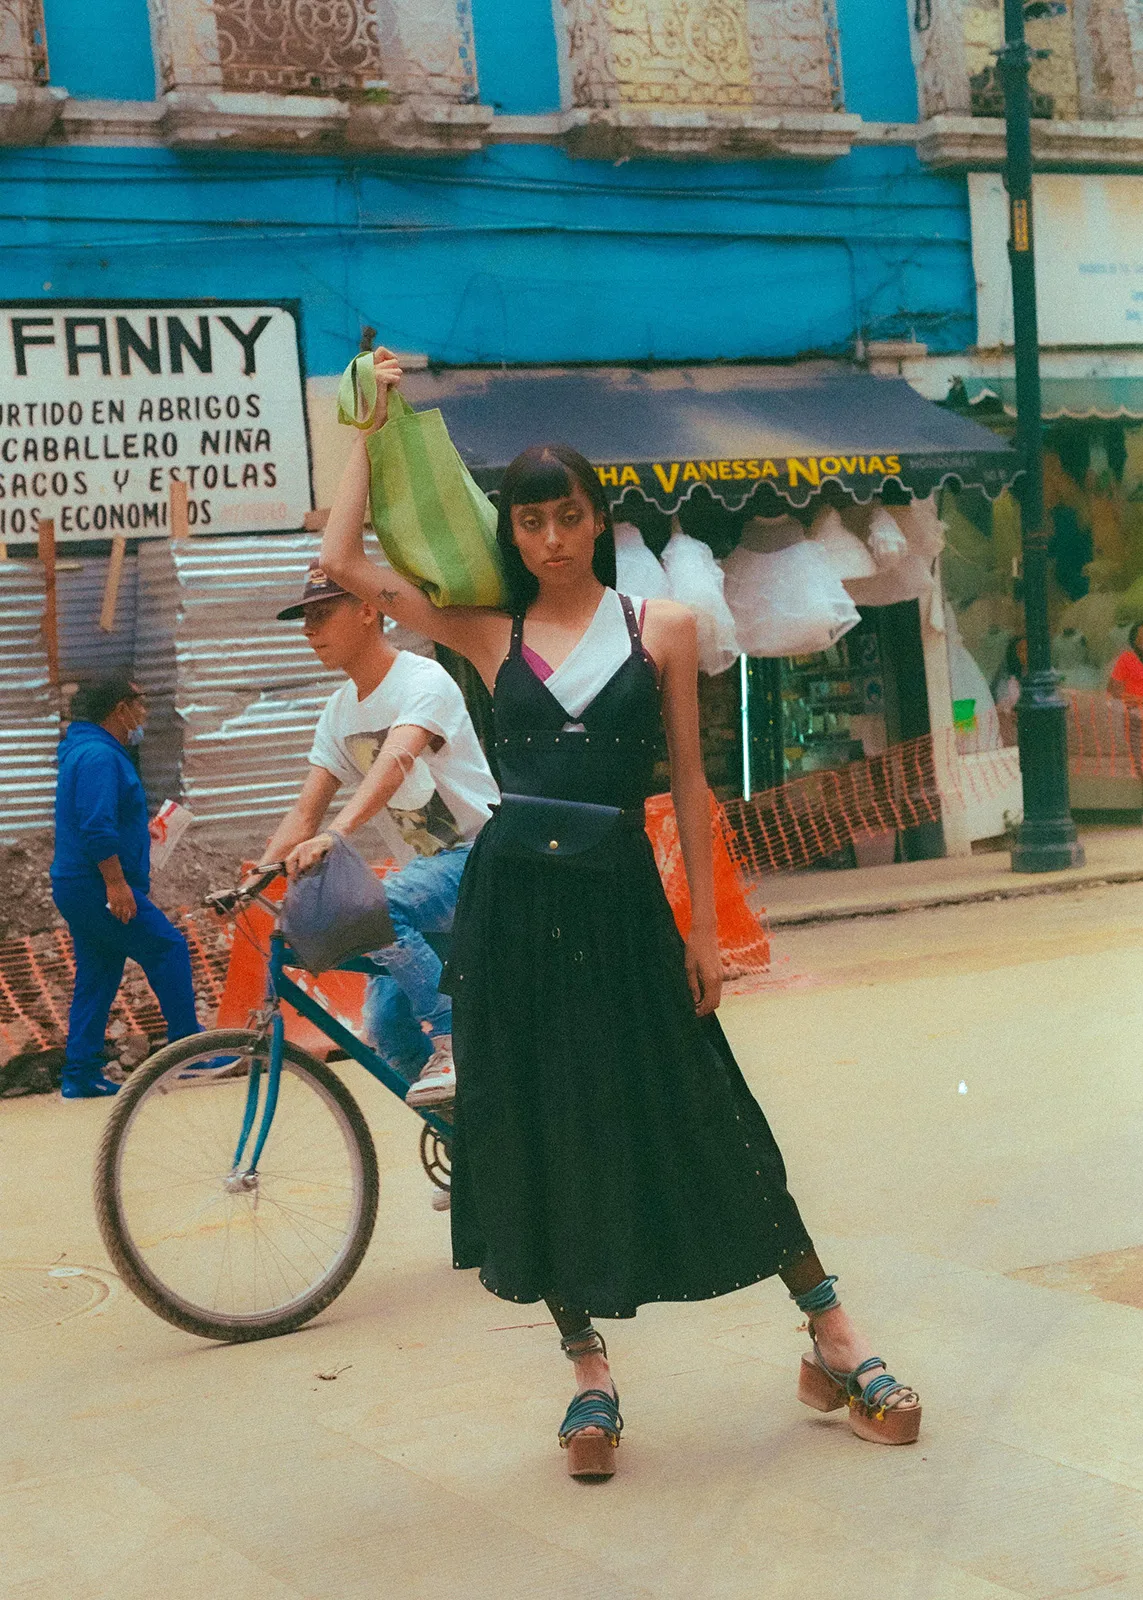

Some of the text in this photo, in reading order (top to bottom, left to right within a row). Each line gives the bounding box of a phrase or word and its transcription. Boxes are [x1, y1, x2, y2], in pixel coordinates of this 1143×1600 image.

[11, 315, 273, 376] FANNY
[0, 394, 261, 427] RTIDO EN ABRIGOS
[2, 428, 271, 462] CABALLERO NIÑA
[114, 469, 129, 493] Y
[150, 462, 277, 492] ESTOLAS
[652, 459, 779, 493] VANESSA
[786, 455, 902, 487] NOVIAS
[61, 499, 212, 532] ECONOMIOS
